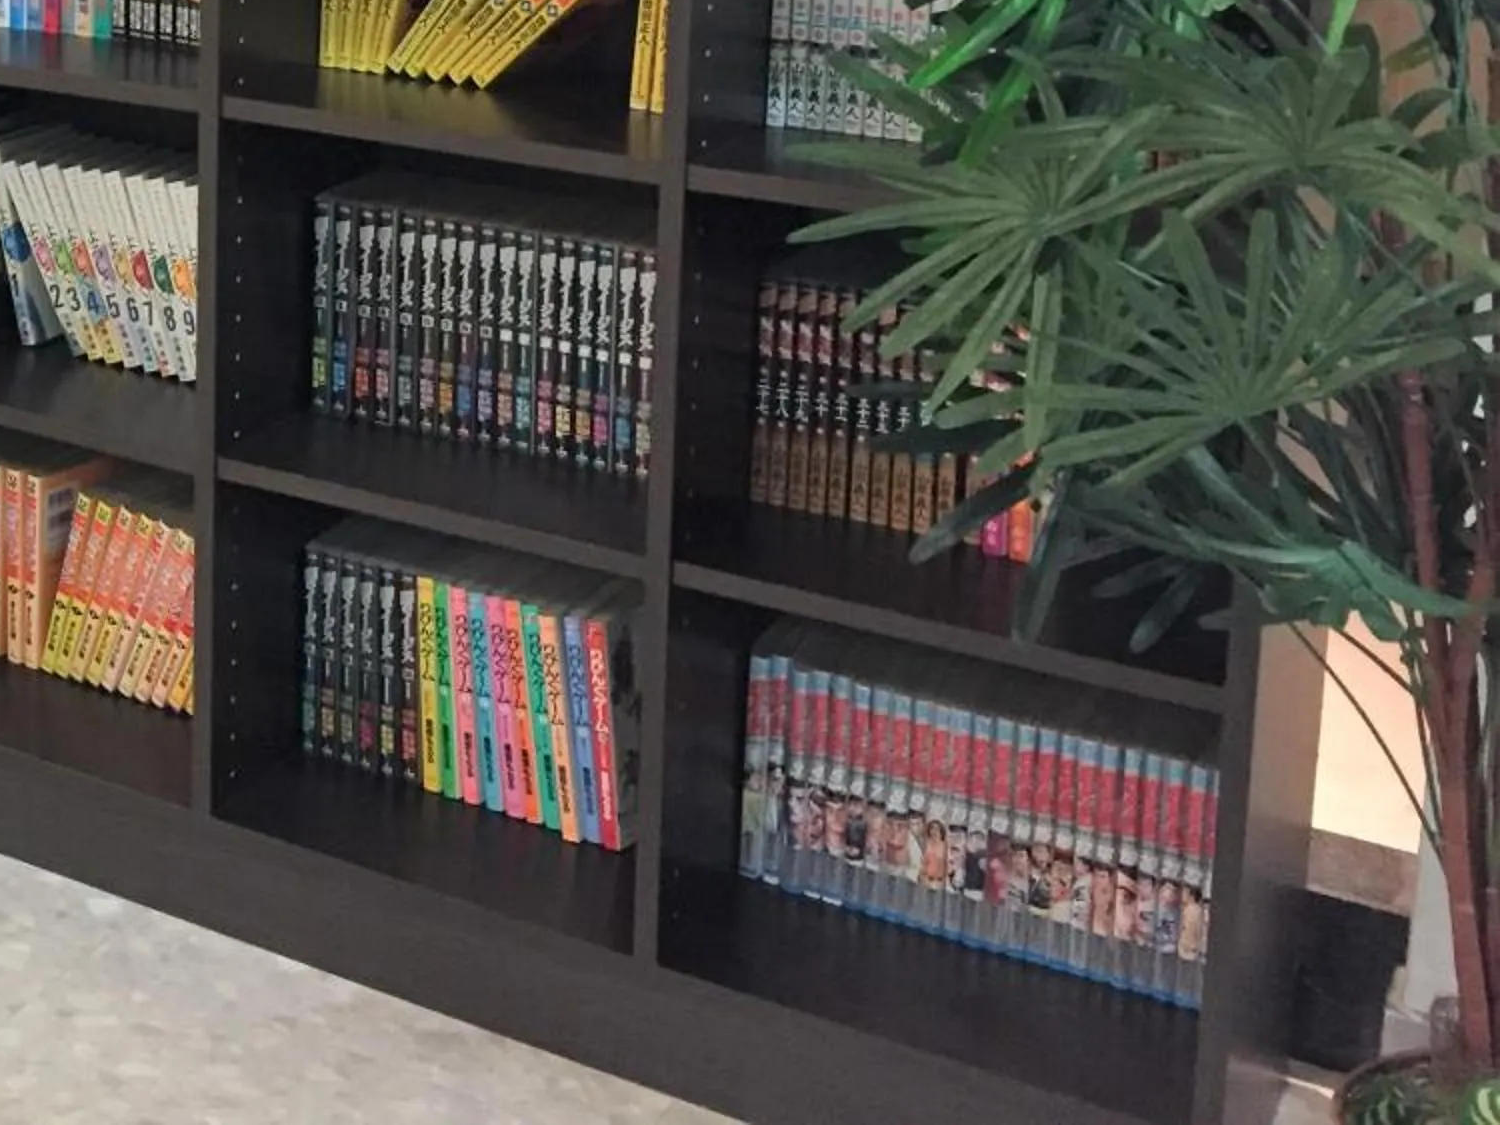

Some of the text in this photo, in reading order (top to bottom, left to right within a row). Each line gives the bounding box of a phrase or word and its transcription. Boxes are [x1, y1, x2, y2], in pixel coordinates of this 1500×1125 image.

[49, 284, 64, 308] 2
[67, 287, 81, 311] 3
[87, 290, 100, 313] 4
[105, 293, 120, 318] 5
[126, 297, 140, 322] 6
[142, 301, 154, 326] 7
[163, 306, 177, 331] 8
[183, 310, 195, 335] 9
